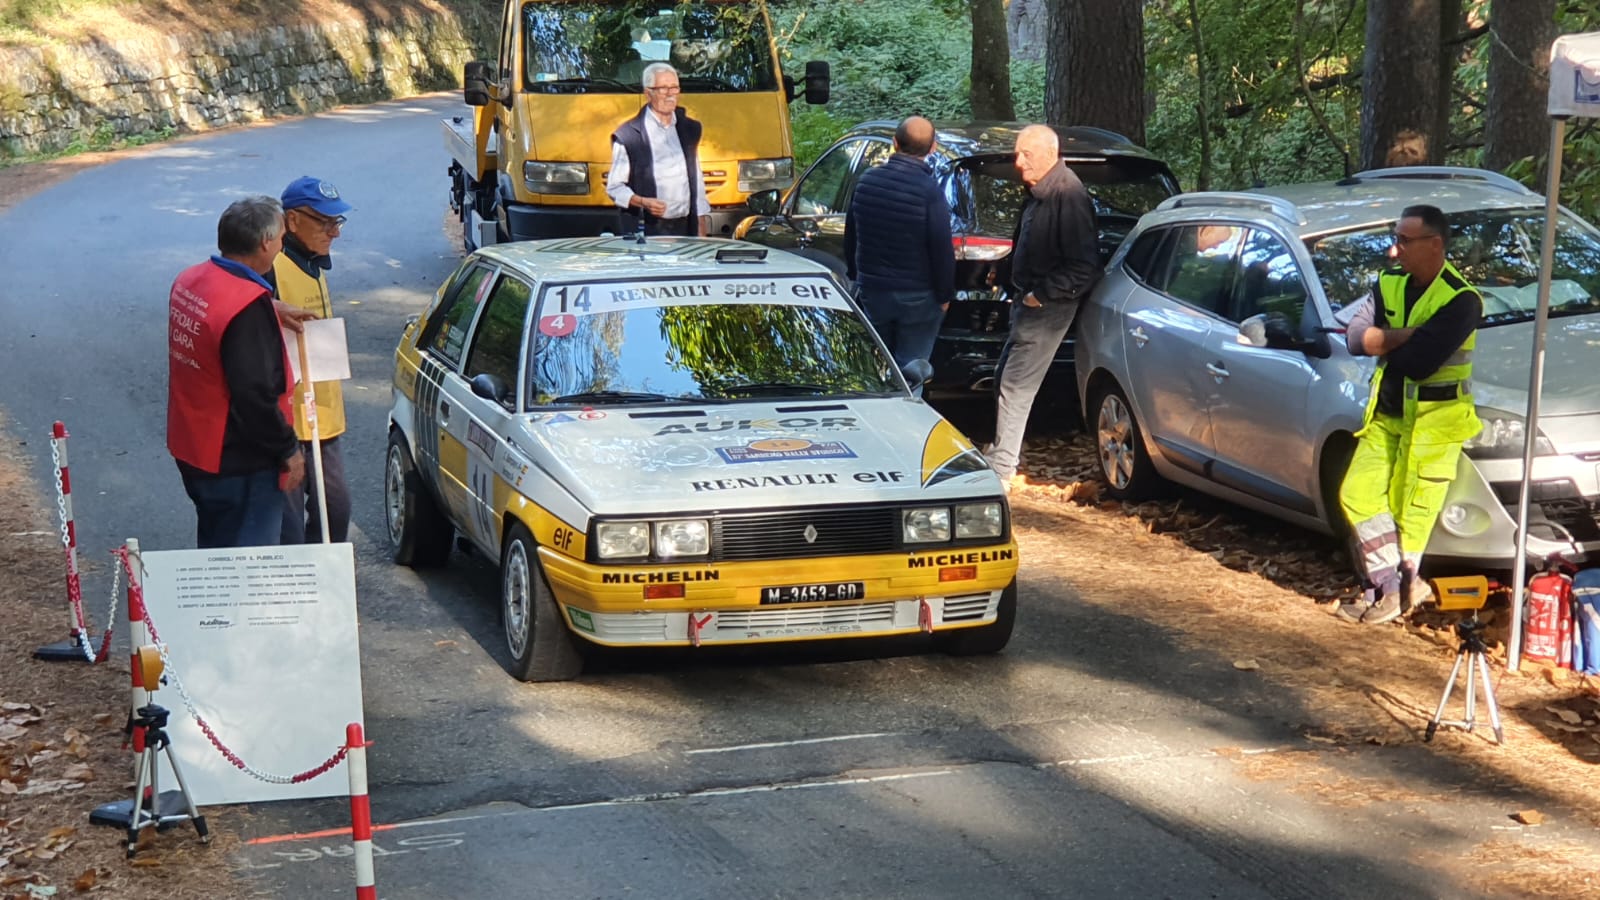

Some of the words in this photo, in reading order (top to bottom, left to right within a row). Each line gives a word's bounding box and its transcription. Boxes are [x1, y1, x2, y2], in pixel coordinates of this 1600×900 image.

[555, 286, 592, 313] 14
[610, 284, 711, 303] RENAULT
[724, 281, 777, 298] sport
[791, 284, 832, 300] elf
[170, 306, 201, 336] FFICIALE
[550, 315, 565, 329] 4
[173, 329, 195, 351] GARA
[654, 417, 858, 436] AUKOR
[784, 450, 809, 458] RALLY
[689, 472, 838, 492] RENAULT
[852, 471, 905, 483] elf
[553, 527, 574, 551] elf
[908, 549, 1013, 569] MICHELIN
[601, 569, 720, 584] MICHELIN
[768, 583, 857, 604] M-3653-GD
